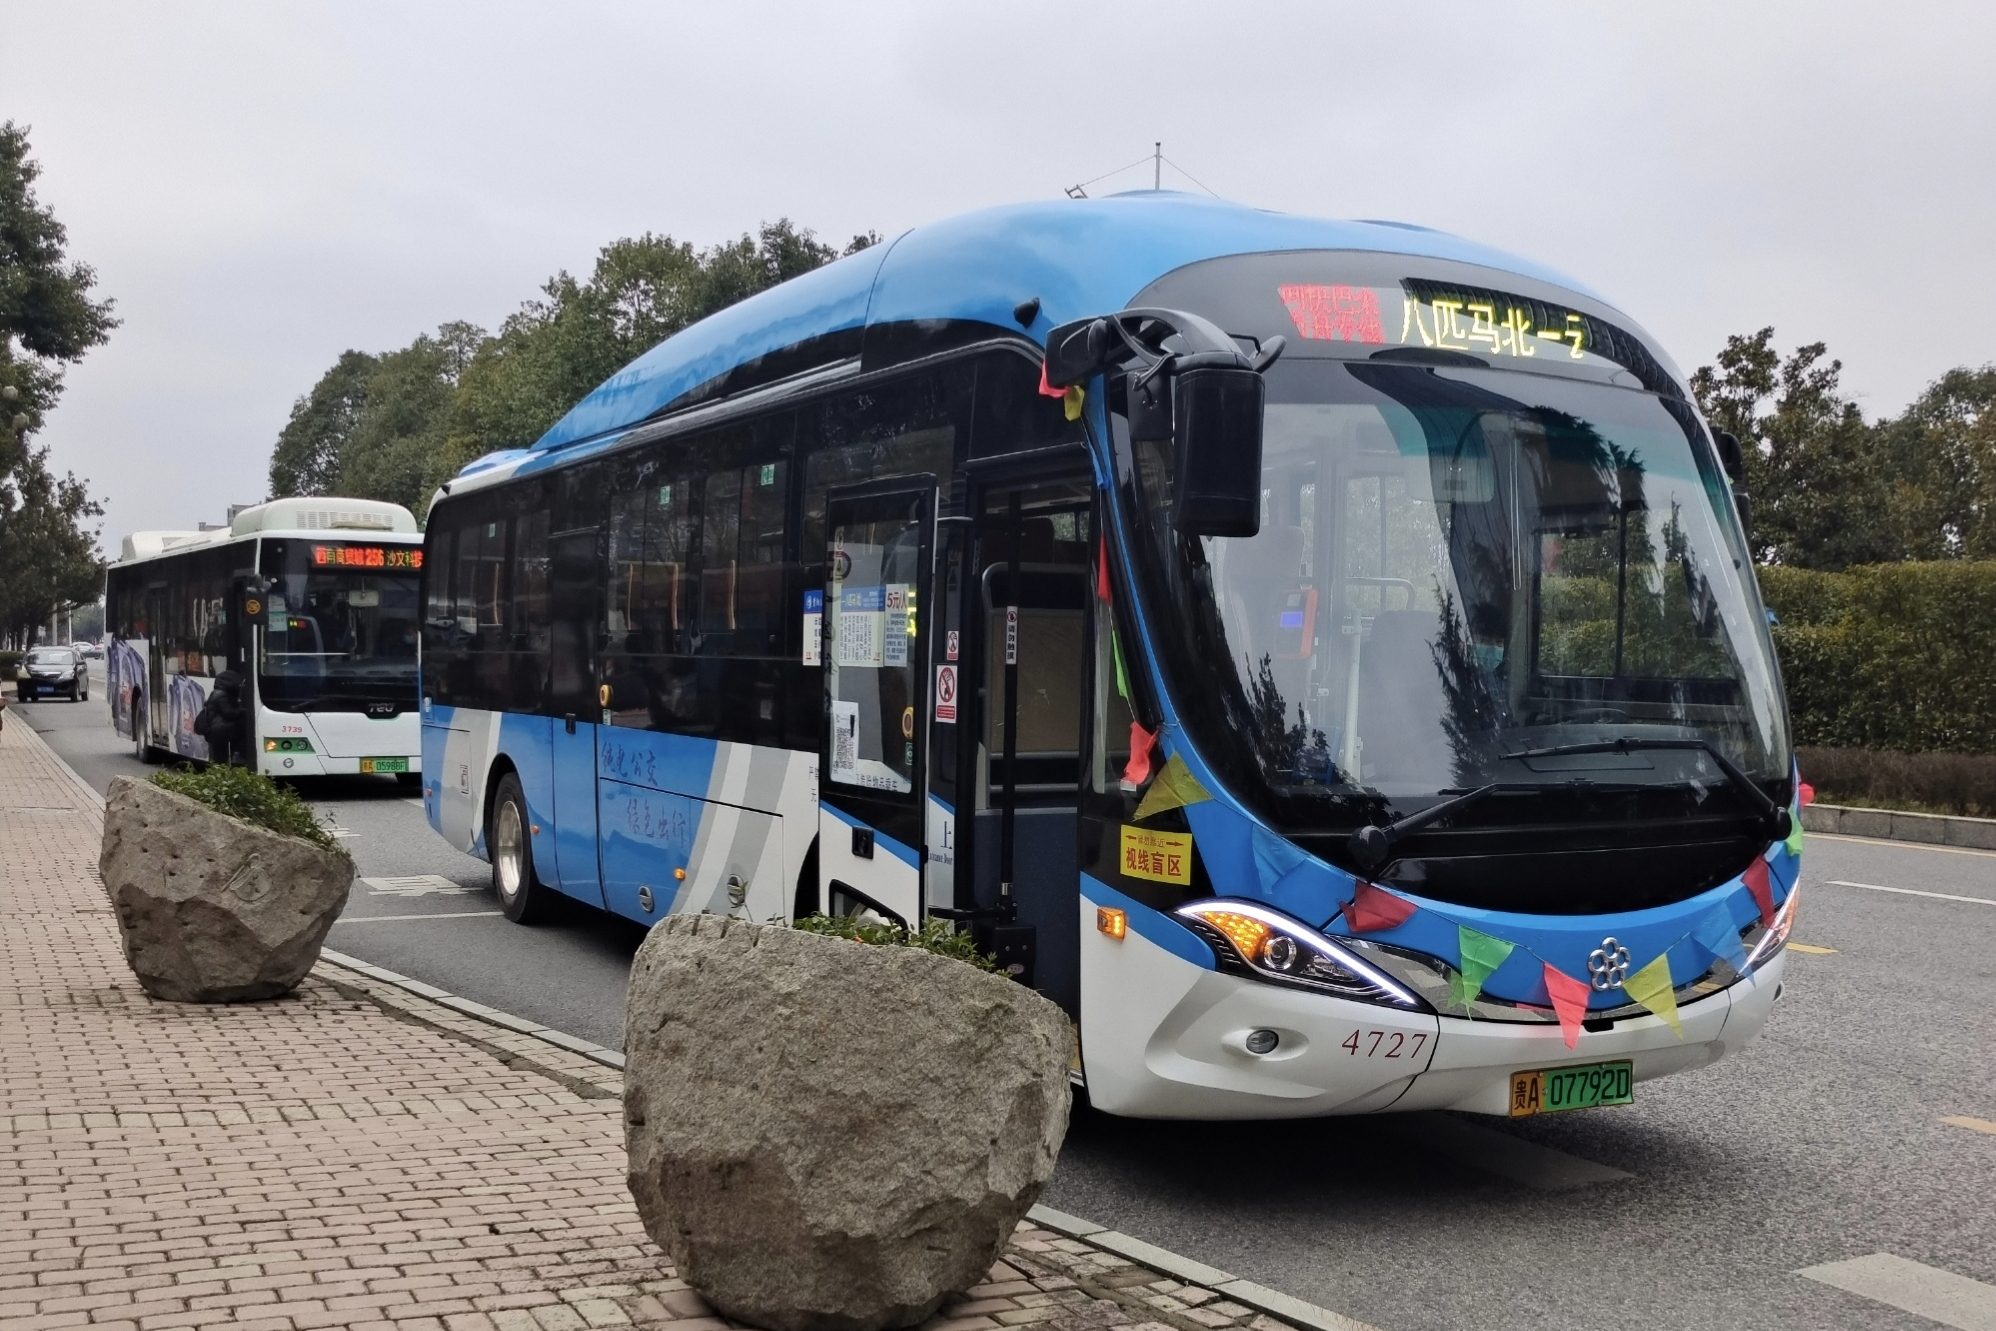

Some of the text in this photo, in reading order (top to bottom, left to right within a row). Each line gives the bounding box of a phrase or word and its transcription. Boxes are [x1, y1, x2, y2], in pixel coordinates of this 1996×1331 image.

[365, 547, 384, 566] 256
[1007, 624, 1016, 660] 请勿触摸
[281, 725, 303, 734] 3739
[601, 740, 659, 787] 纯电公交
[627, 798, 687, 849] 绿色出行
[1126, 846, 1182, 877] 视线盲区
[1341, 1029, 1428, 1059] 4727
